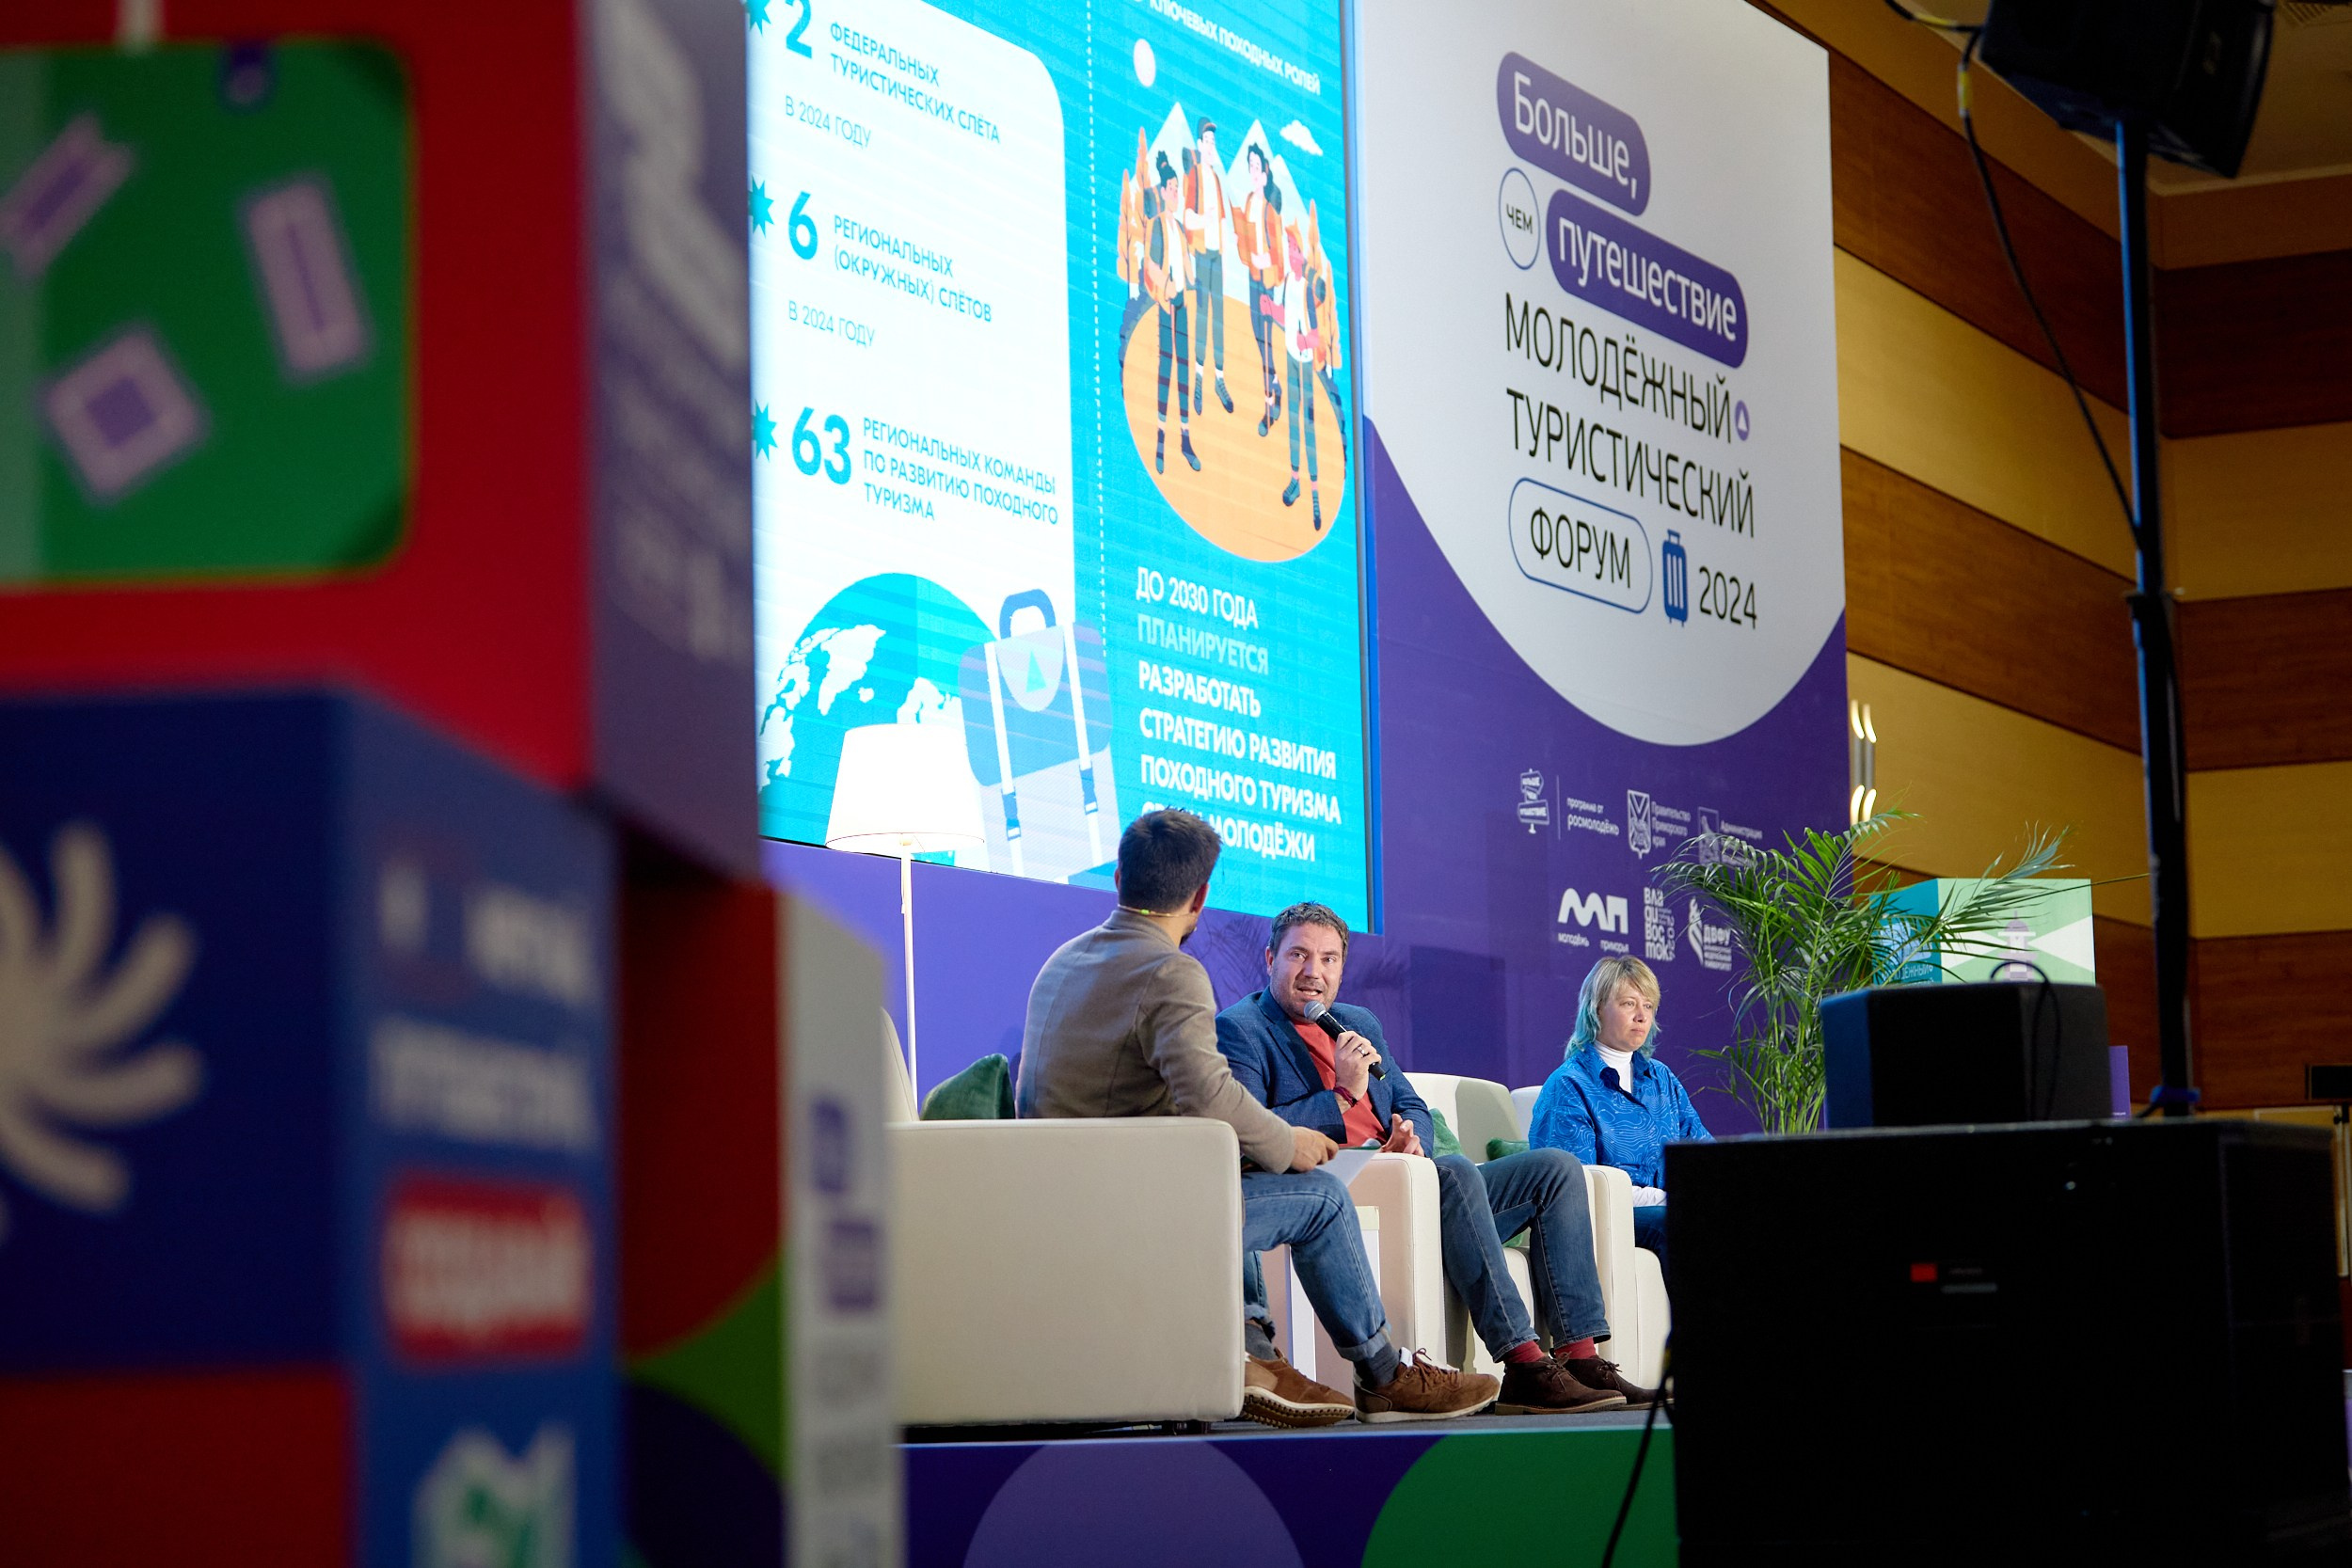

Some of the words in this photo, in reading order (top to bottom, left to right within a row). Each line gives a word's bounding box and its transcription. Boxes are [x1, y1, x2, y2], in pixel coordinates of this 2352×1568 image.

[786, 0, 813, 59] 2
[830, 22, 940, 87] ФЕДЕРАЛЬНЫХ
[1149, 0, 1218, 42] КЛЮЧЕВЫХ
[1218, 27, 1285, 77] ПОХОДНЫХ
[1284, 62, 1321, 95] РОЛЕЙ
[785, 95, 795, 117] В
[799, 101, 831, 132] 2024
[834, 117, 871, 150] ГОДУ
[830, 53, 954, 124] ТУРИСТИЧЕСКИХ
[958, 108, 1001, 144] СЛЁТА
[1514, 71, 1638, 199] Больше,
[788, 191, 818, 260] 6
[834, 214, 954, 277] РЕГИОНАЛЬНЫХ
[834, 245, 934, 305] (ОКРУЖНЫХ)
[939, 286, 993, 323] СЛЁТОВ
[1559, 216, 1738, 342] путешествие
[788, 300, 798, 321] В
[802, 306, 834, 334] 2024
[838, 317, 875, 348] ГОДУ
[1505, 292, 1731, 444] МОЛОДЁЖНЫЙ
[791, 406, 851, 485] 63
[863, 417, 981, 468] РЕГИОНАЛЬНЫХ
[985, 456, 1057, 495] КОМАНДЫ
[1506, 387, 1755, 538] ТУРИСТИЧЕСКИЙ
[864, 450, 886, 474] ПО
[890, 457, 970, 499] РАЗВИТИЮ
[974, 483, 1058, 525] ПОХОДНОГО
[864, 483, 935, 521] ТУРИЗМА
[1136, 566, 1164, 603] ДО
[1168, 577, 1208, 614] 2030
[1213, 588, 1260, 631] ГОДА
[1531, 507, 1631, 589] ФОРУМ
[1699, 566, 1757, 630] 2024
[1137, 613, 1269, 676] ПЛАНИРУЕТСЯ
[1138, 659, 1262, 718] РАЗРАБОТАТЬ
[1139, 706, 1246, 759] СТРАТЕГИЮ
[1249, 732, 1337, 780] РАЗВИТИЯ
[1140, 753, 1257, 806] ПОХОДНОГО
[1259, 780, 1343, 825] ТУРИЗМА
[1209, 815, 1316, 863] МОЛОДЁЖИ
